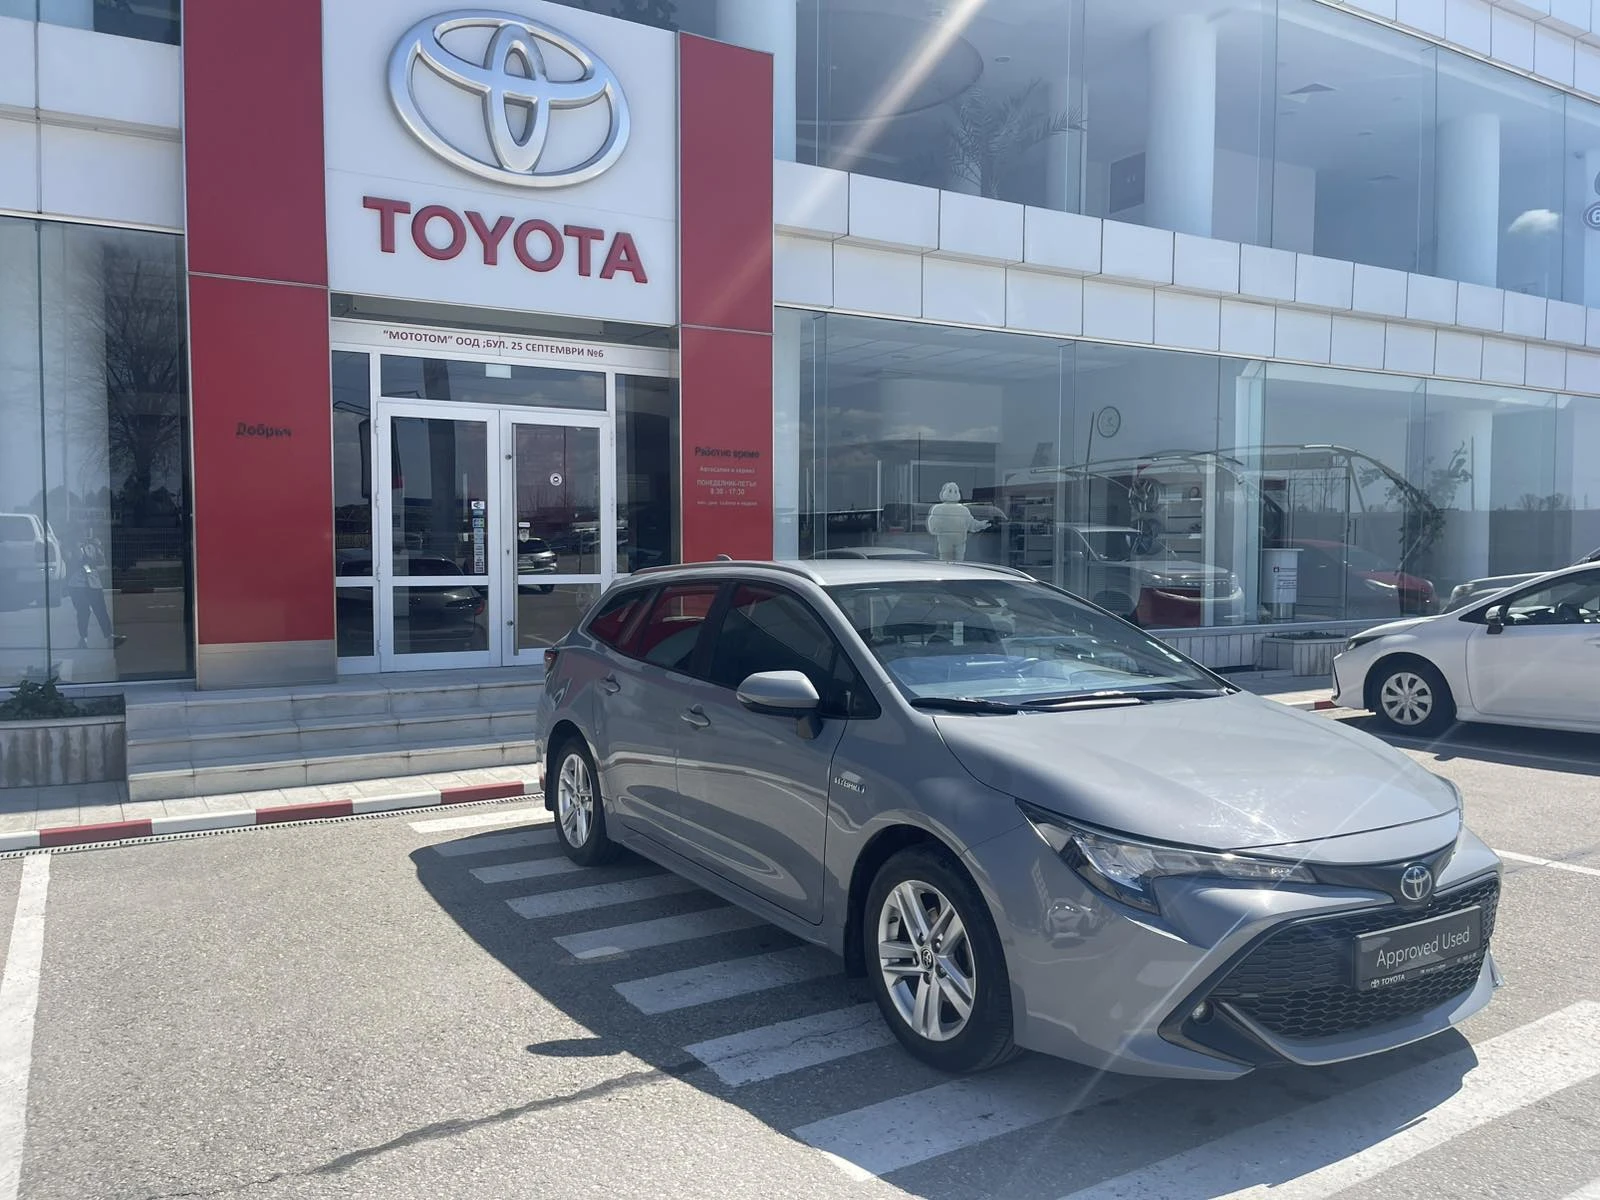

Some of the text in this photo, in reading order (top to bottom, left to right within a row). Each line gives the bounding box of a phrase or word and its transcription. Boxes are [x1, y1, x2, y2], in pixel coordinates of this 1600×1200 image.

[363, 195, 648, 284] TOYOTA
[456, 336, 480, 348] ООД
[511, 341, 523, 351] 25
[525, 343, 585, 356] СЕПТЕМВРИ
[1376, 925, 1470, 969] Approved Used
[1381, 973, 1405, 986] TOYOTA
